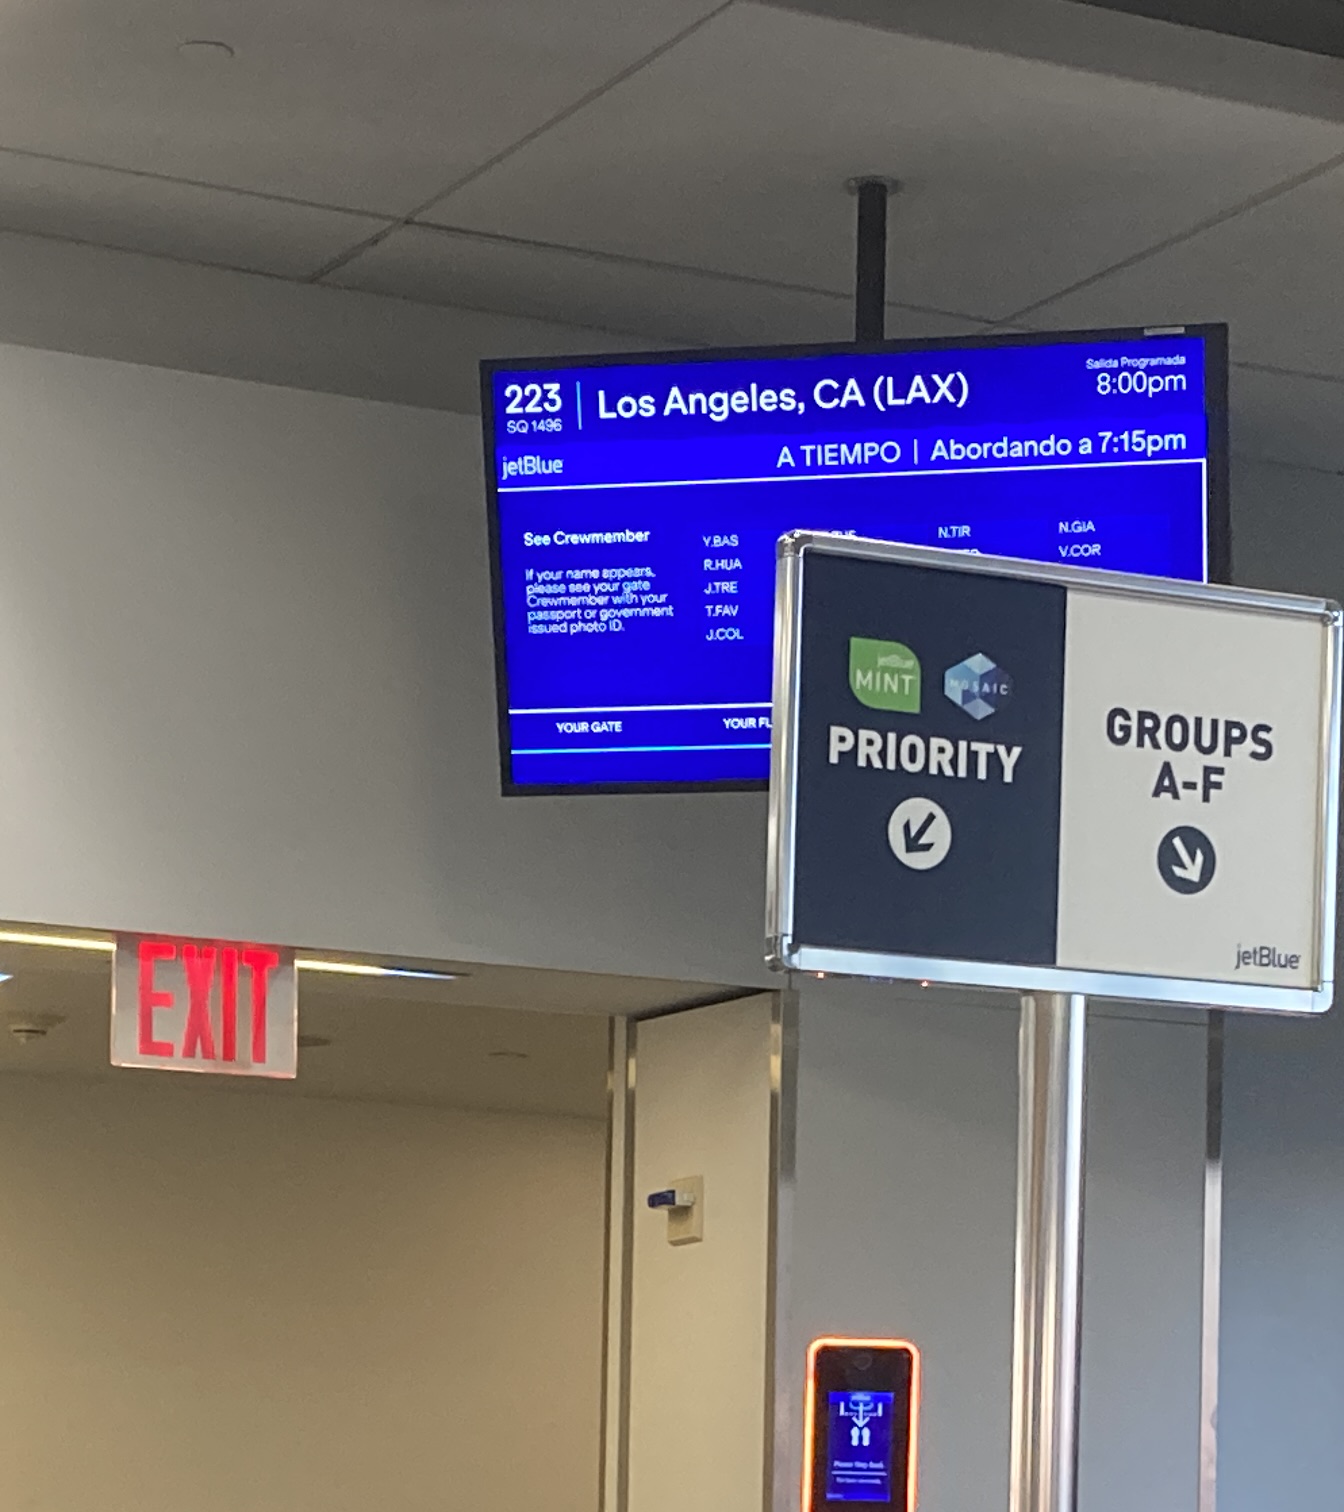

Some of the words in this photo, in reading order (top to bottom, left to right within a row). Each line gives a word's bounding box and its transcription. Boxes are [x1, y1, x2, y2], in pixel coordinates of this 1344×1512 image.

[1096, 371, 1187, 398] 8:00pm
[504, 383, 562, 414] 223
[597, 390, 656, 419] Los
[663, 383, 806, 422] Angeles,
[813, 377, 866, 409] CA
[873, 371, 969, 412] (LAX)
[506, 420, 529, 434] SQ
[531, 418, 563, 432] 1496
[776, 446, 796, 468] A
[800, 441, 901, 467] TIEMPO
[929, 434, 1073, 461] Abordando
[1078, 437, 1093, 454] a
[1098, 430, 1187, 457] 7:15pm
[501, 455, 564, 480] jetBlue
[937, 525, 971, 538] N.TIR
[1058, 520, 1096, 534] N.GIA
[523, 532, 551, 546] See
[553, 529, 651, 545] Crewmember
[702, 534, 739, 548] Y.BAS
[1058, 544, 1102, 557] V.COR
[703, 558, 743, 571] R.HUA
[524, 569, 534, 581] If
[536, 570, 564, 583] your
[566, 569, 599, 579] name
[526, 582, 566, 595] please
[593, 582, 620, 596] your
[622, 580, 651, 593] gate
[703, 581, 739, 594] J.TRE
[526, 594, 609, 607] Crewmember
[640, 593, 669, 606] your
[527, 608, 582, 623] passport
[584, 610, 598, 619] or
[599, 605, 674, 621] government
[705, 604, 739, 617] T.FAV
[528, 621, 568, 634] issued
[570, 621, 606, 635] photo
[706, 628, 744, 640] J.COL
[856, 668, 916, 696] MINT
[555, 721, 590, 733] YOUR
[590, 721, 623, 733] GATE
[722, 717, 757, 729] YOUR
[1105, 707, 1274, 762] GROUPS
[828, 724, 1023, 784] PRIORITY
[1151, 761, 1226, 804] A-F
[1234, 943, 1301, 970] jetBlue
[138, 941, 279, 1064] EXIT
